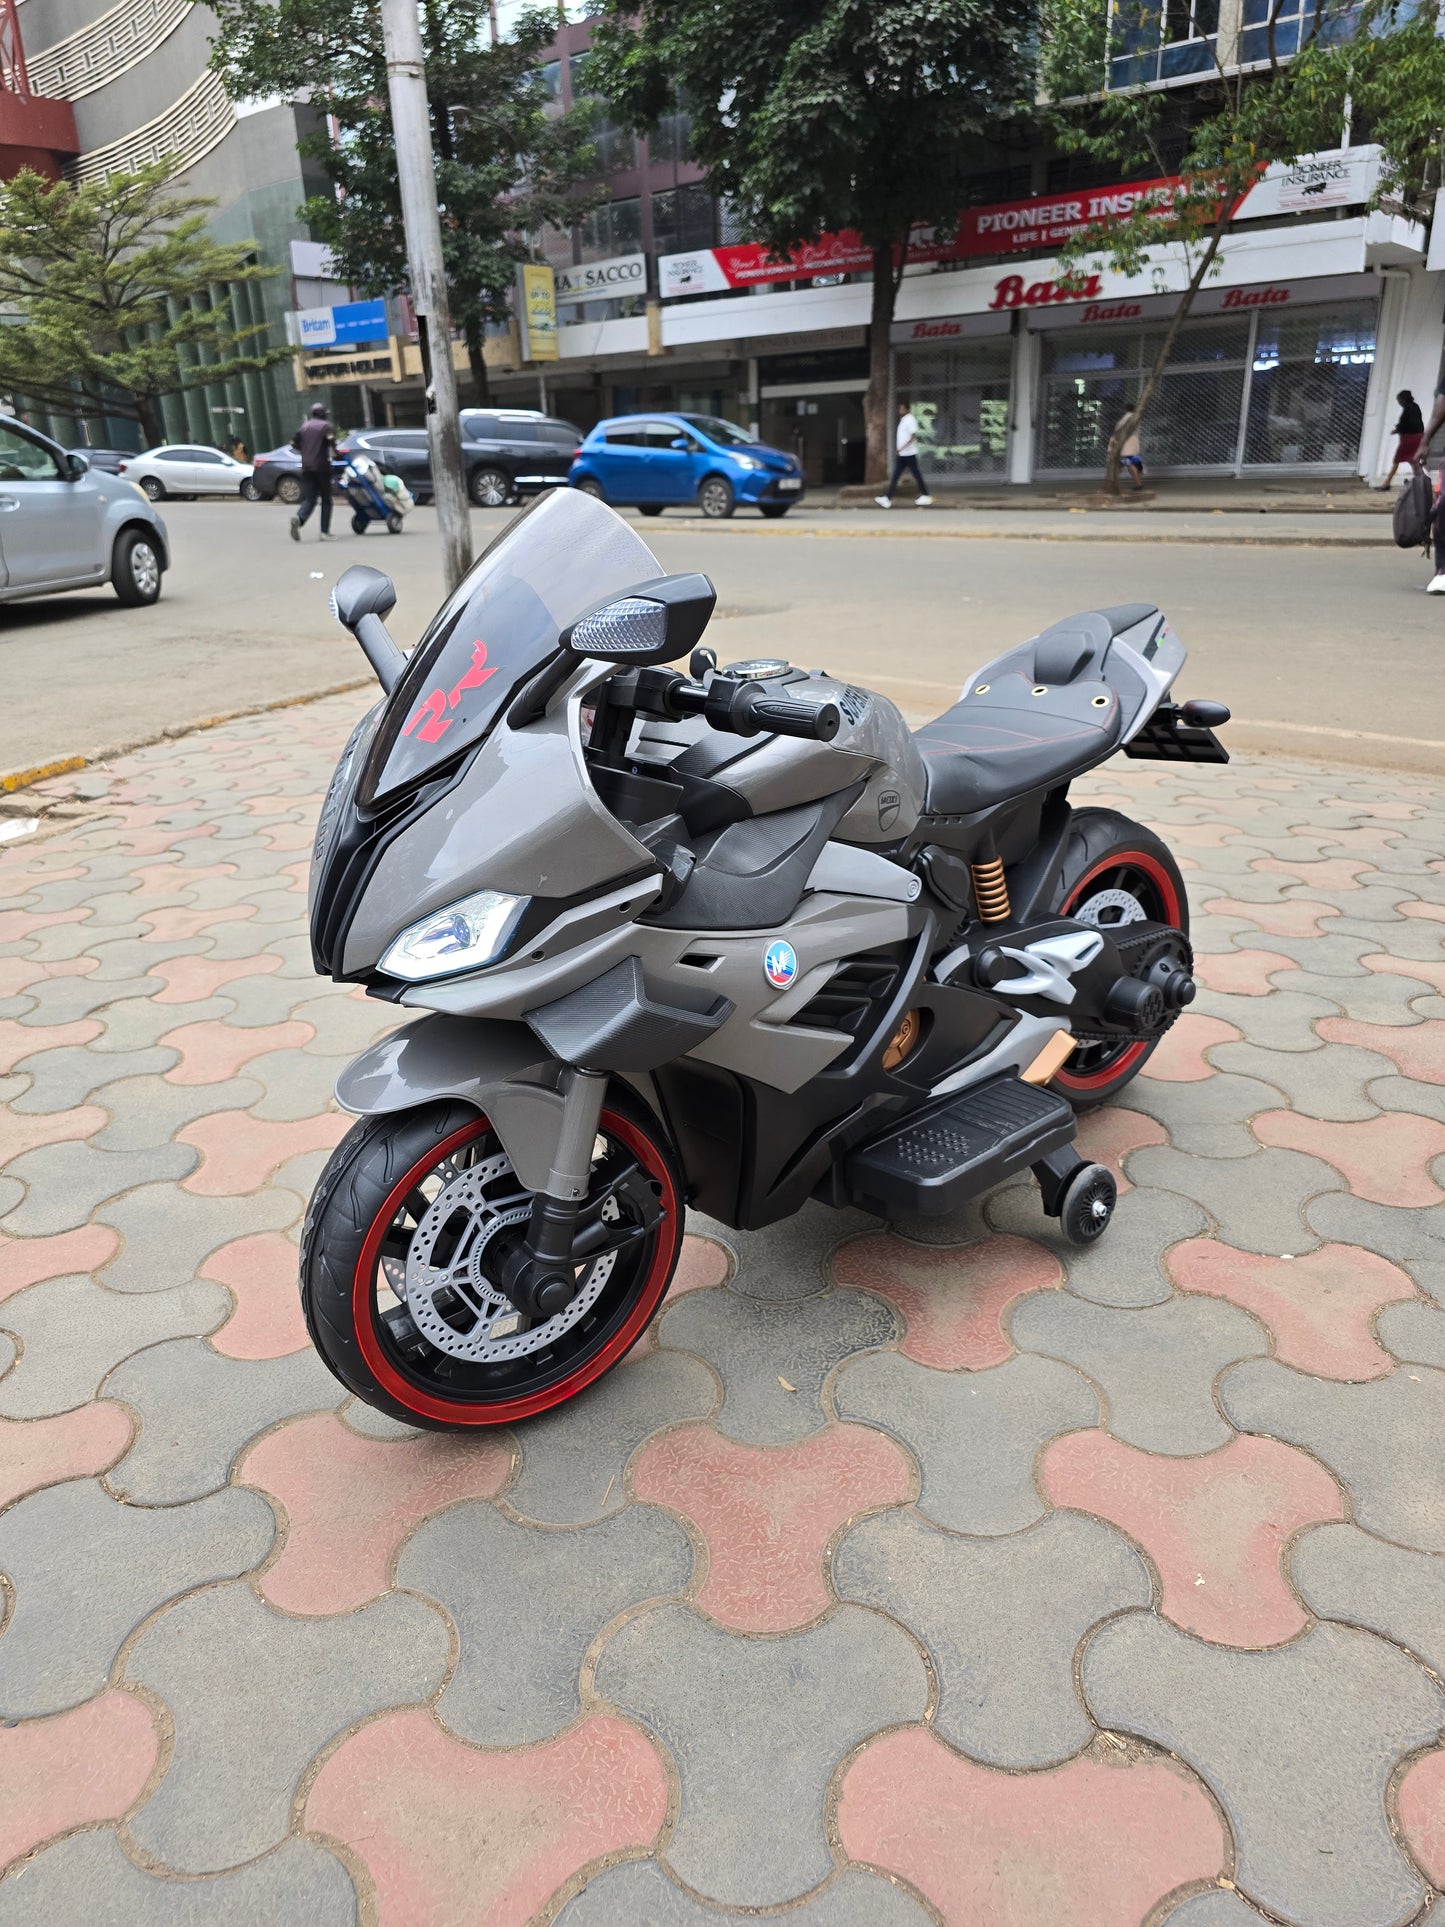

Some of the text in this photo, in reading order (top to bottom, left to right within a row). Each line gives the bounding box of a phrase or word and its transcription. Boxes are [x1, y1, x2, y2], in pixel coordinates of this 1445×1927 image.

[1281, 167, 1352, 187] INSURANCE
[976, 201, 1083, 234] PIONEER
[1012, 230, 1039, 244] LIFE
[585, 262, 642, 286] SACCO
[1219, 285, 1291, 310] Bata
[1080, 303, 1142, 323] Bata
[302, 319, 331, 333] Britam
[910, 320, 963, 339] Bata
